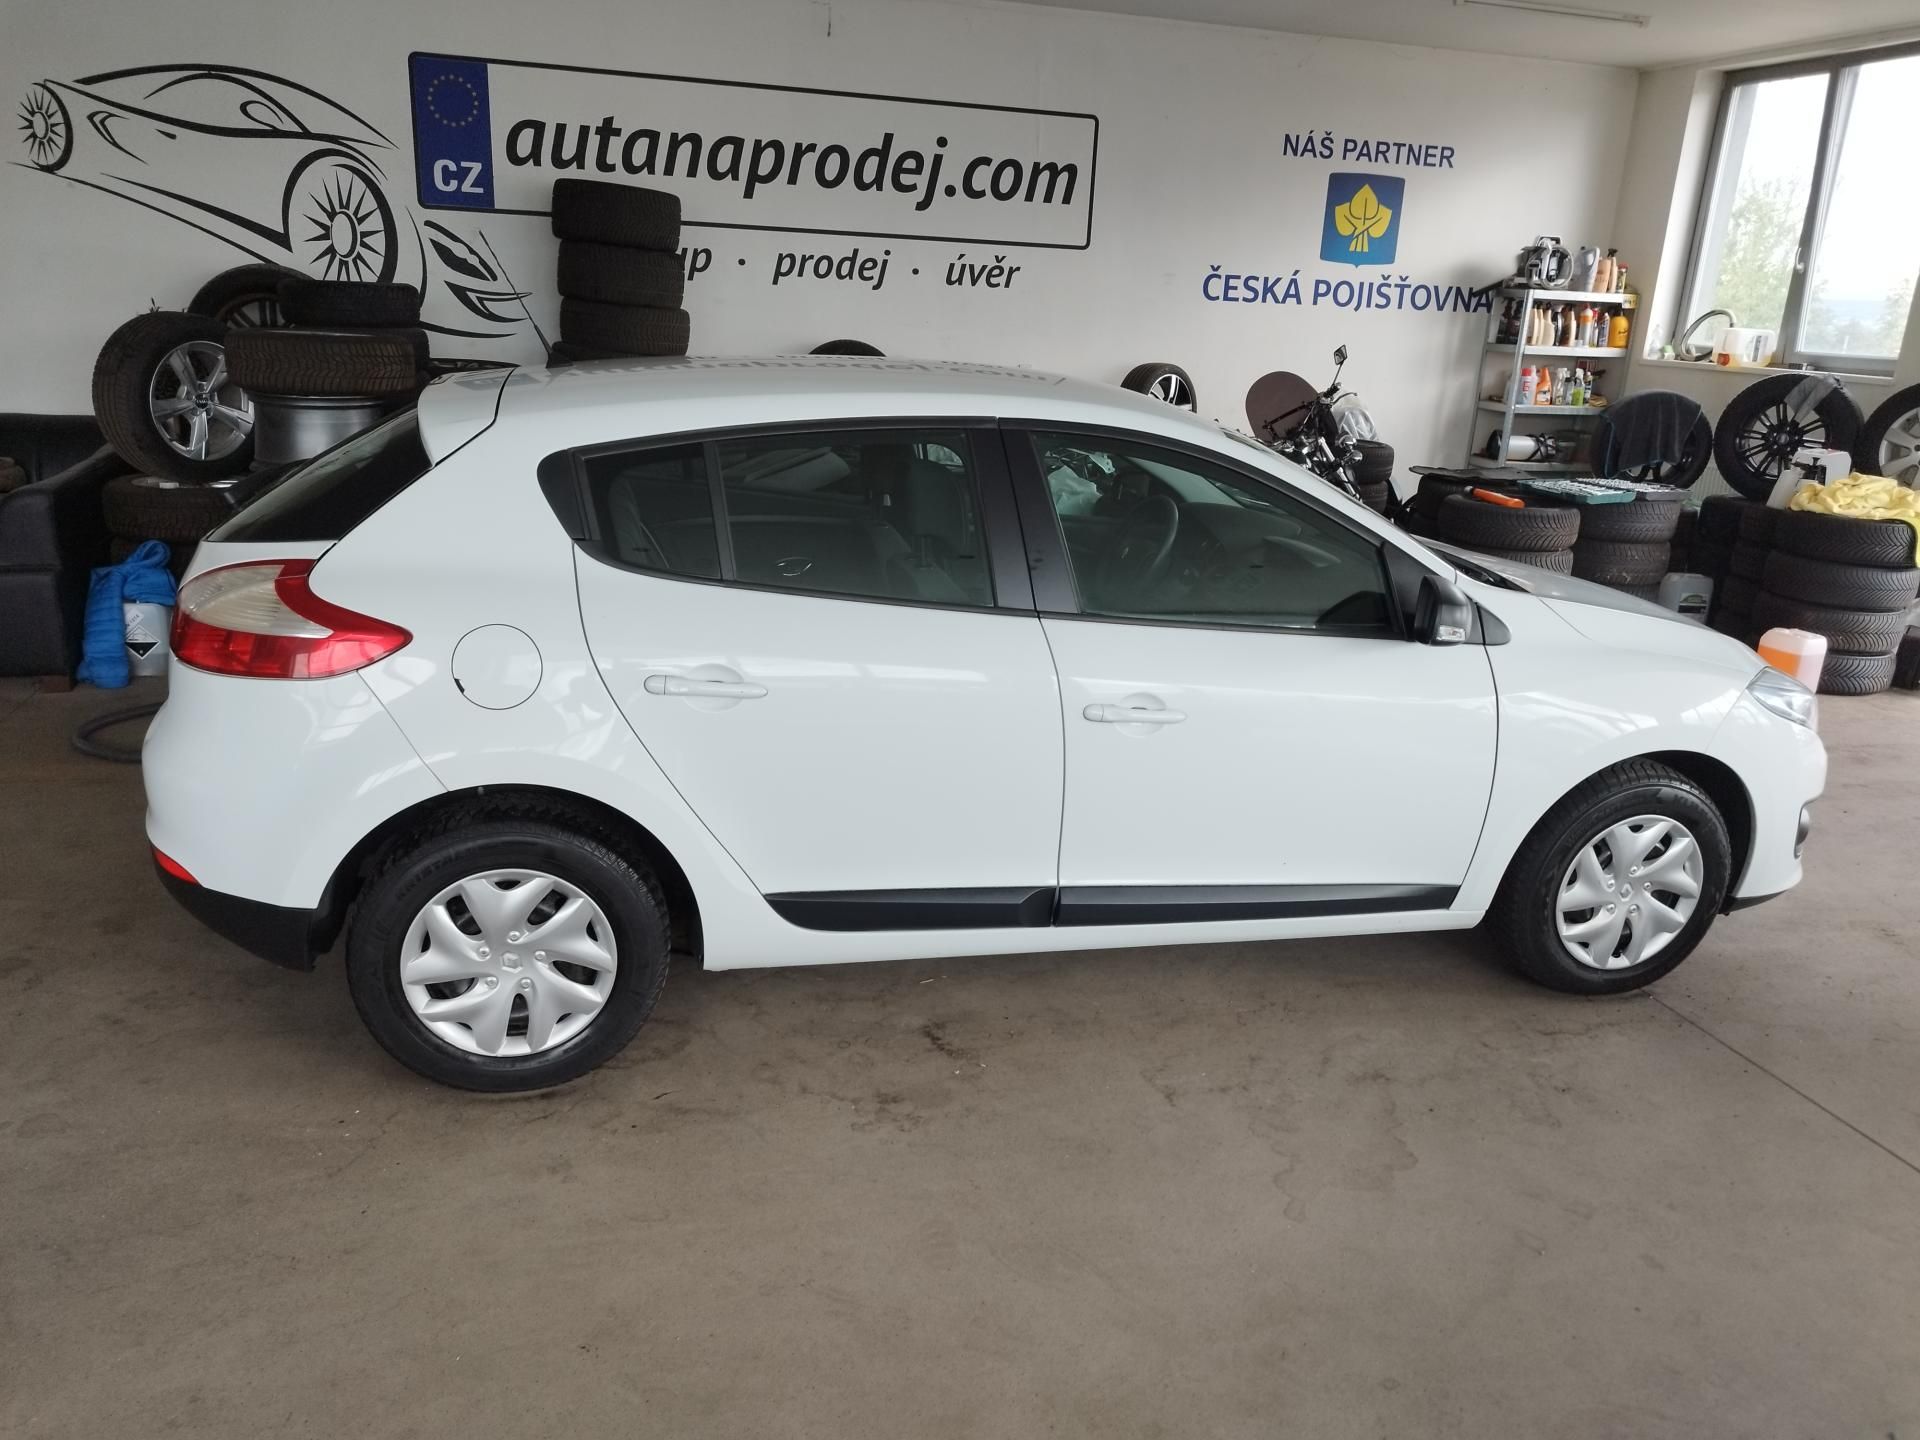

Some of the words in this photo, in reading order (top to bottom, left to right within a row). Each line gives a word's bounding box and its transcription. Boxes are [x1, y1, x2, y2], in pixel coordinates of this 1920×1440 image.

[505, 115, 1079, 212] autanaprodej.com
[1282, 129, 1335, 160] NÁŠ
[1341, 138, 1455, 169] PARTNER
[433, 159, 485, 193] CZ
[772, 247, 891, 291] prodej
[945, 253, 1021, 289] úvěr
[1202, 264, 1302, 305] ČESKÁ
[1312, 274, 1492, 314] POJIŠŤOVNA
